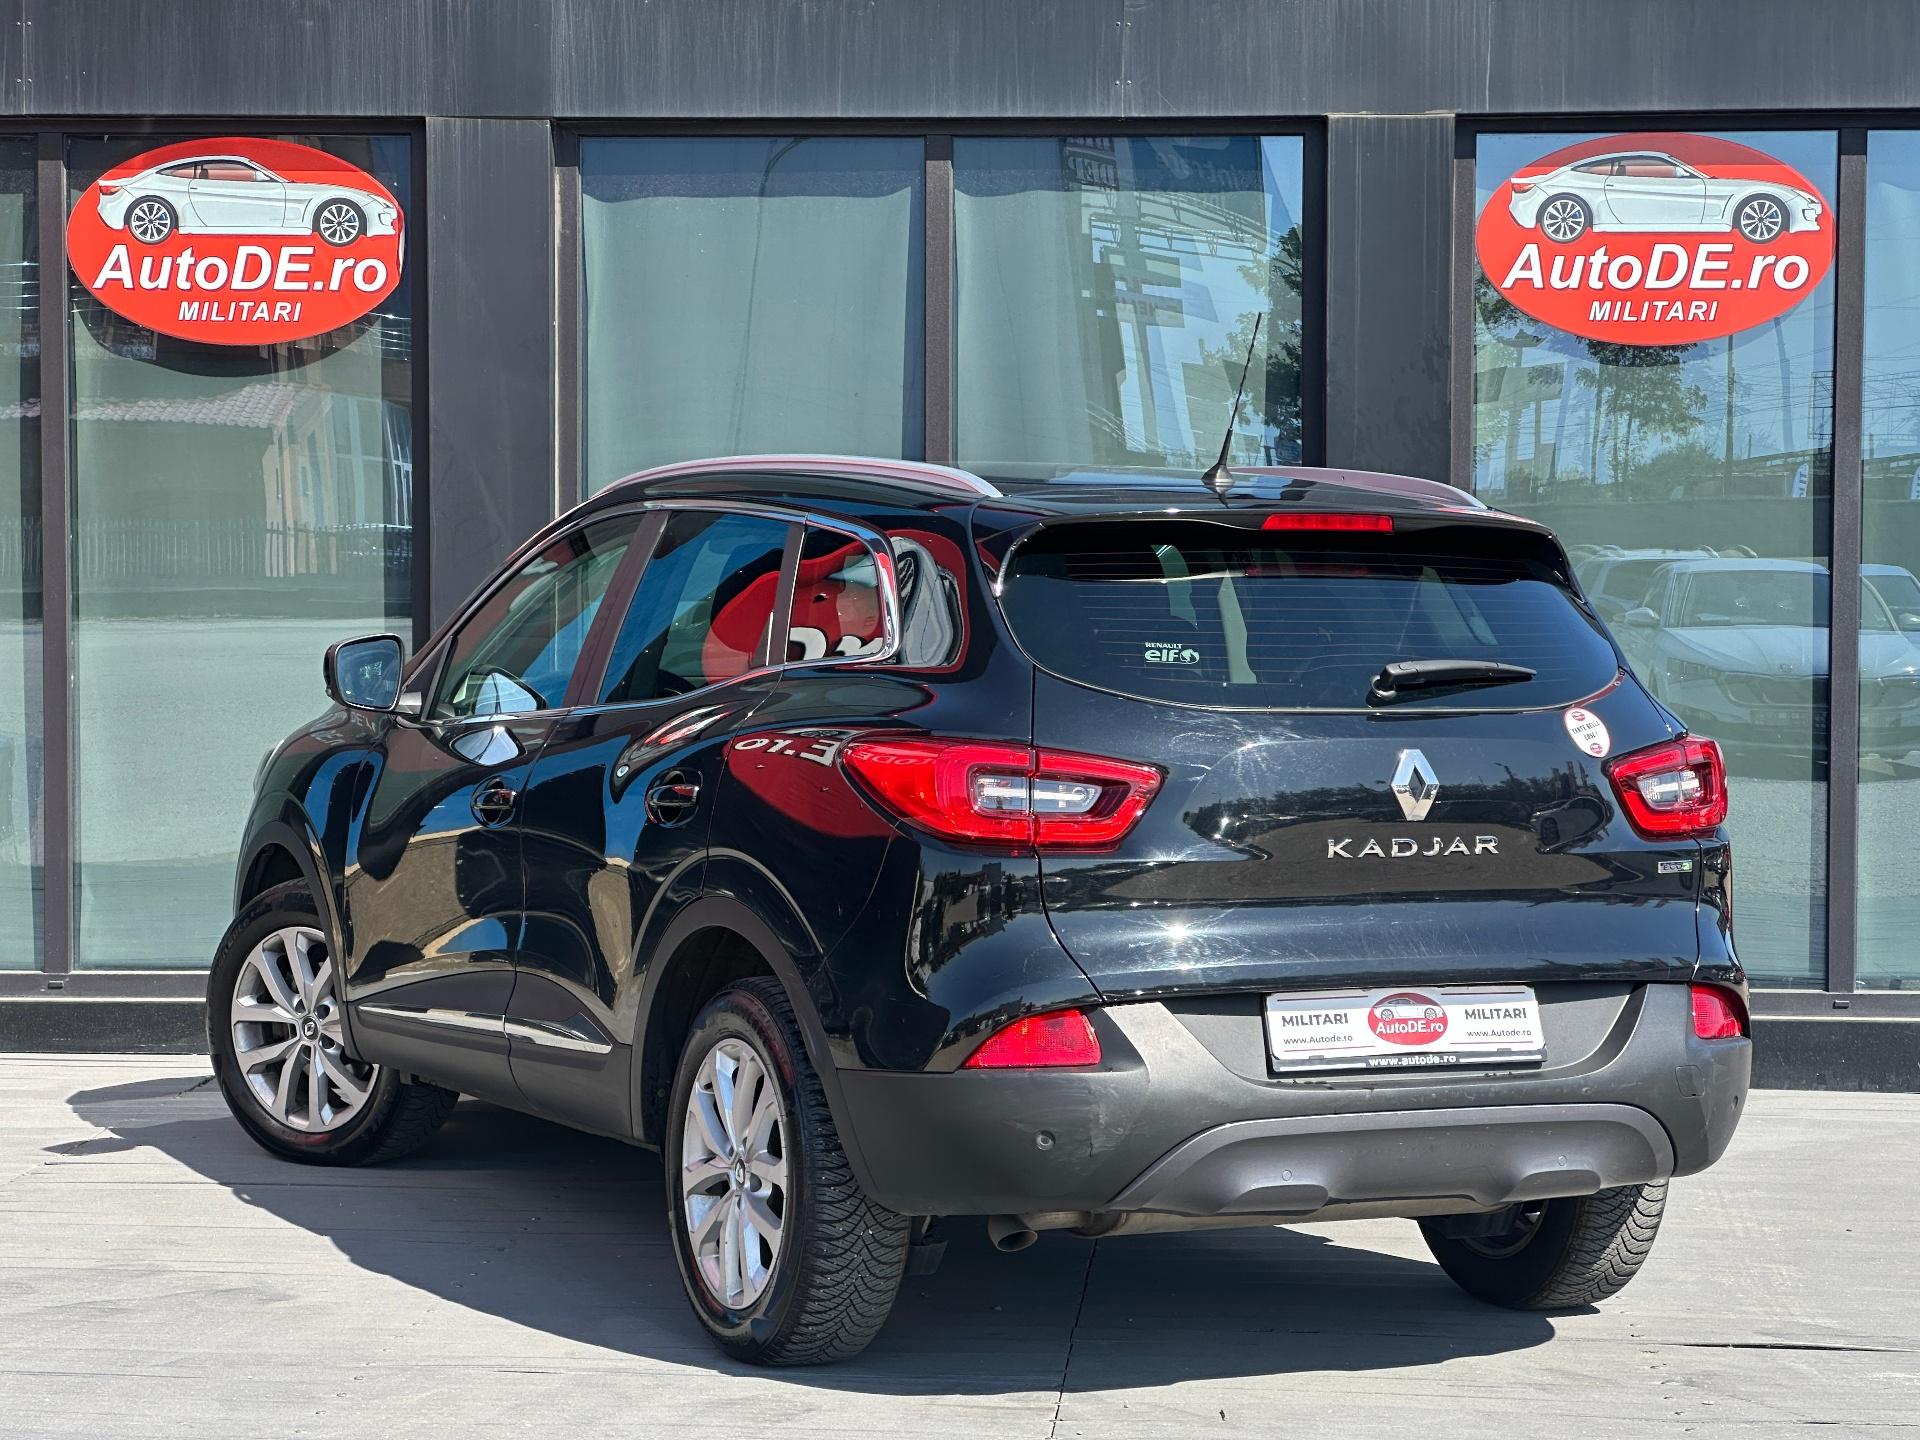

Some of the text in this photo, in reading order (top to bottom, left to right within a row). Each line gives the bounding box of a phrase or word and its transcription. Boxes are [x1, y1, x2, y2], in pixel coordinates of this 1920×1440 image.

[93, 244, 388, 292] AutoDE.ro
[1502, 243, 1810, 290] AutoDE.ro
[178, 301, 302, 323] MILITARI
[1589, 301, 1718, 322] MILITARI
[1144, 649, 1179, 662] elf
[1327, 835, 1499, 859] KADJAR
[1281, 1012, 1349, 1027] MILITARI
[1464, 1007, 1527, 1021] MILITARI
[1375, 1020, 1444, 1035] AutoDE.ro
[1466, 1028, 1532, 1038] www.Autode.ro
[1283, 1034, 1353, 1046] www.Autode.ro
[1368, 1053, 1457, 1067] www.autode.ro
